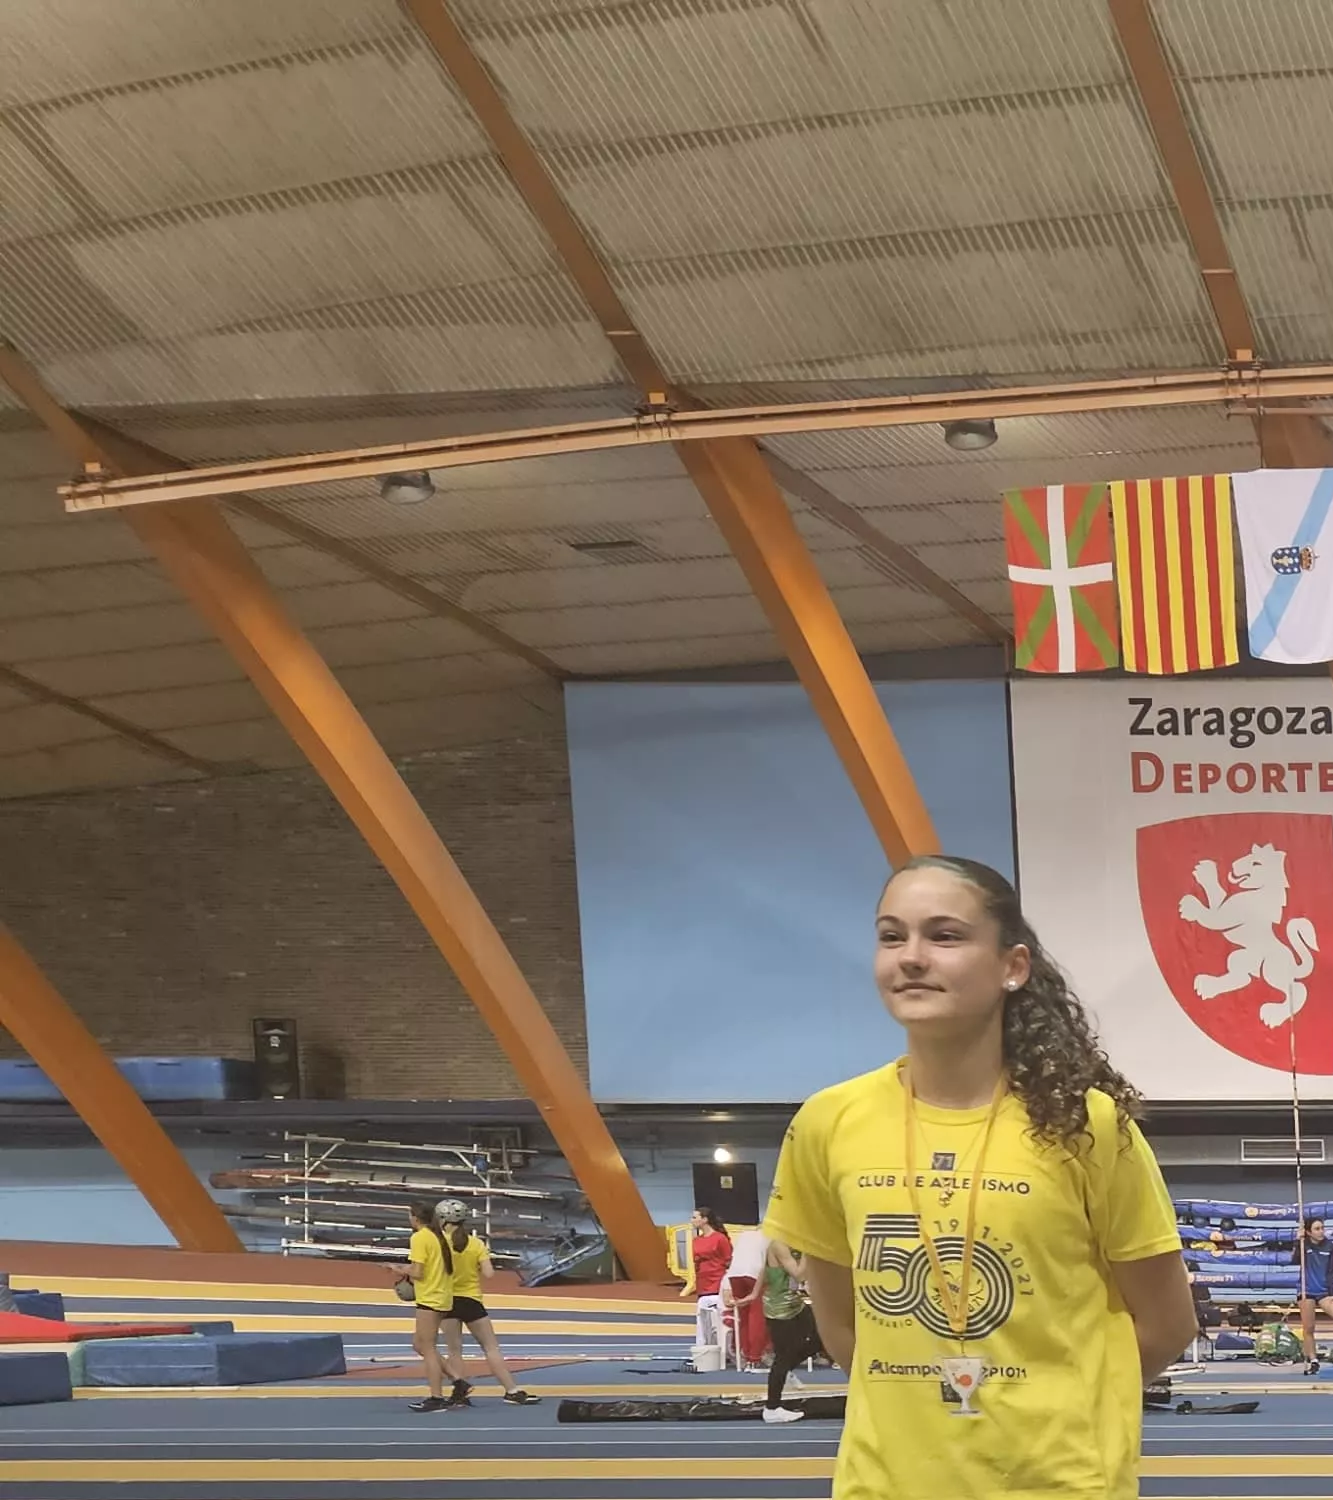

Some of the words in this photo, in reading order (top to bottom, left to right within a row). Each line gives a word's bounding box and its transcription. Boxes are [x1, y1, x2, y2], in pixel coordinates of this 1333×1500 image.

[1128, 697, 1333, 749] Zaragoza
[858, 1175, 896, 1188] CLUB
[929, 1176, 1031, 1195] ATLEISMO
[934, 1218, 1035, 1297] 191-2021
[868, 1359, 942, 1377] Alcampo
